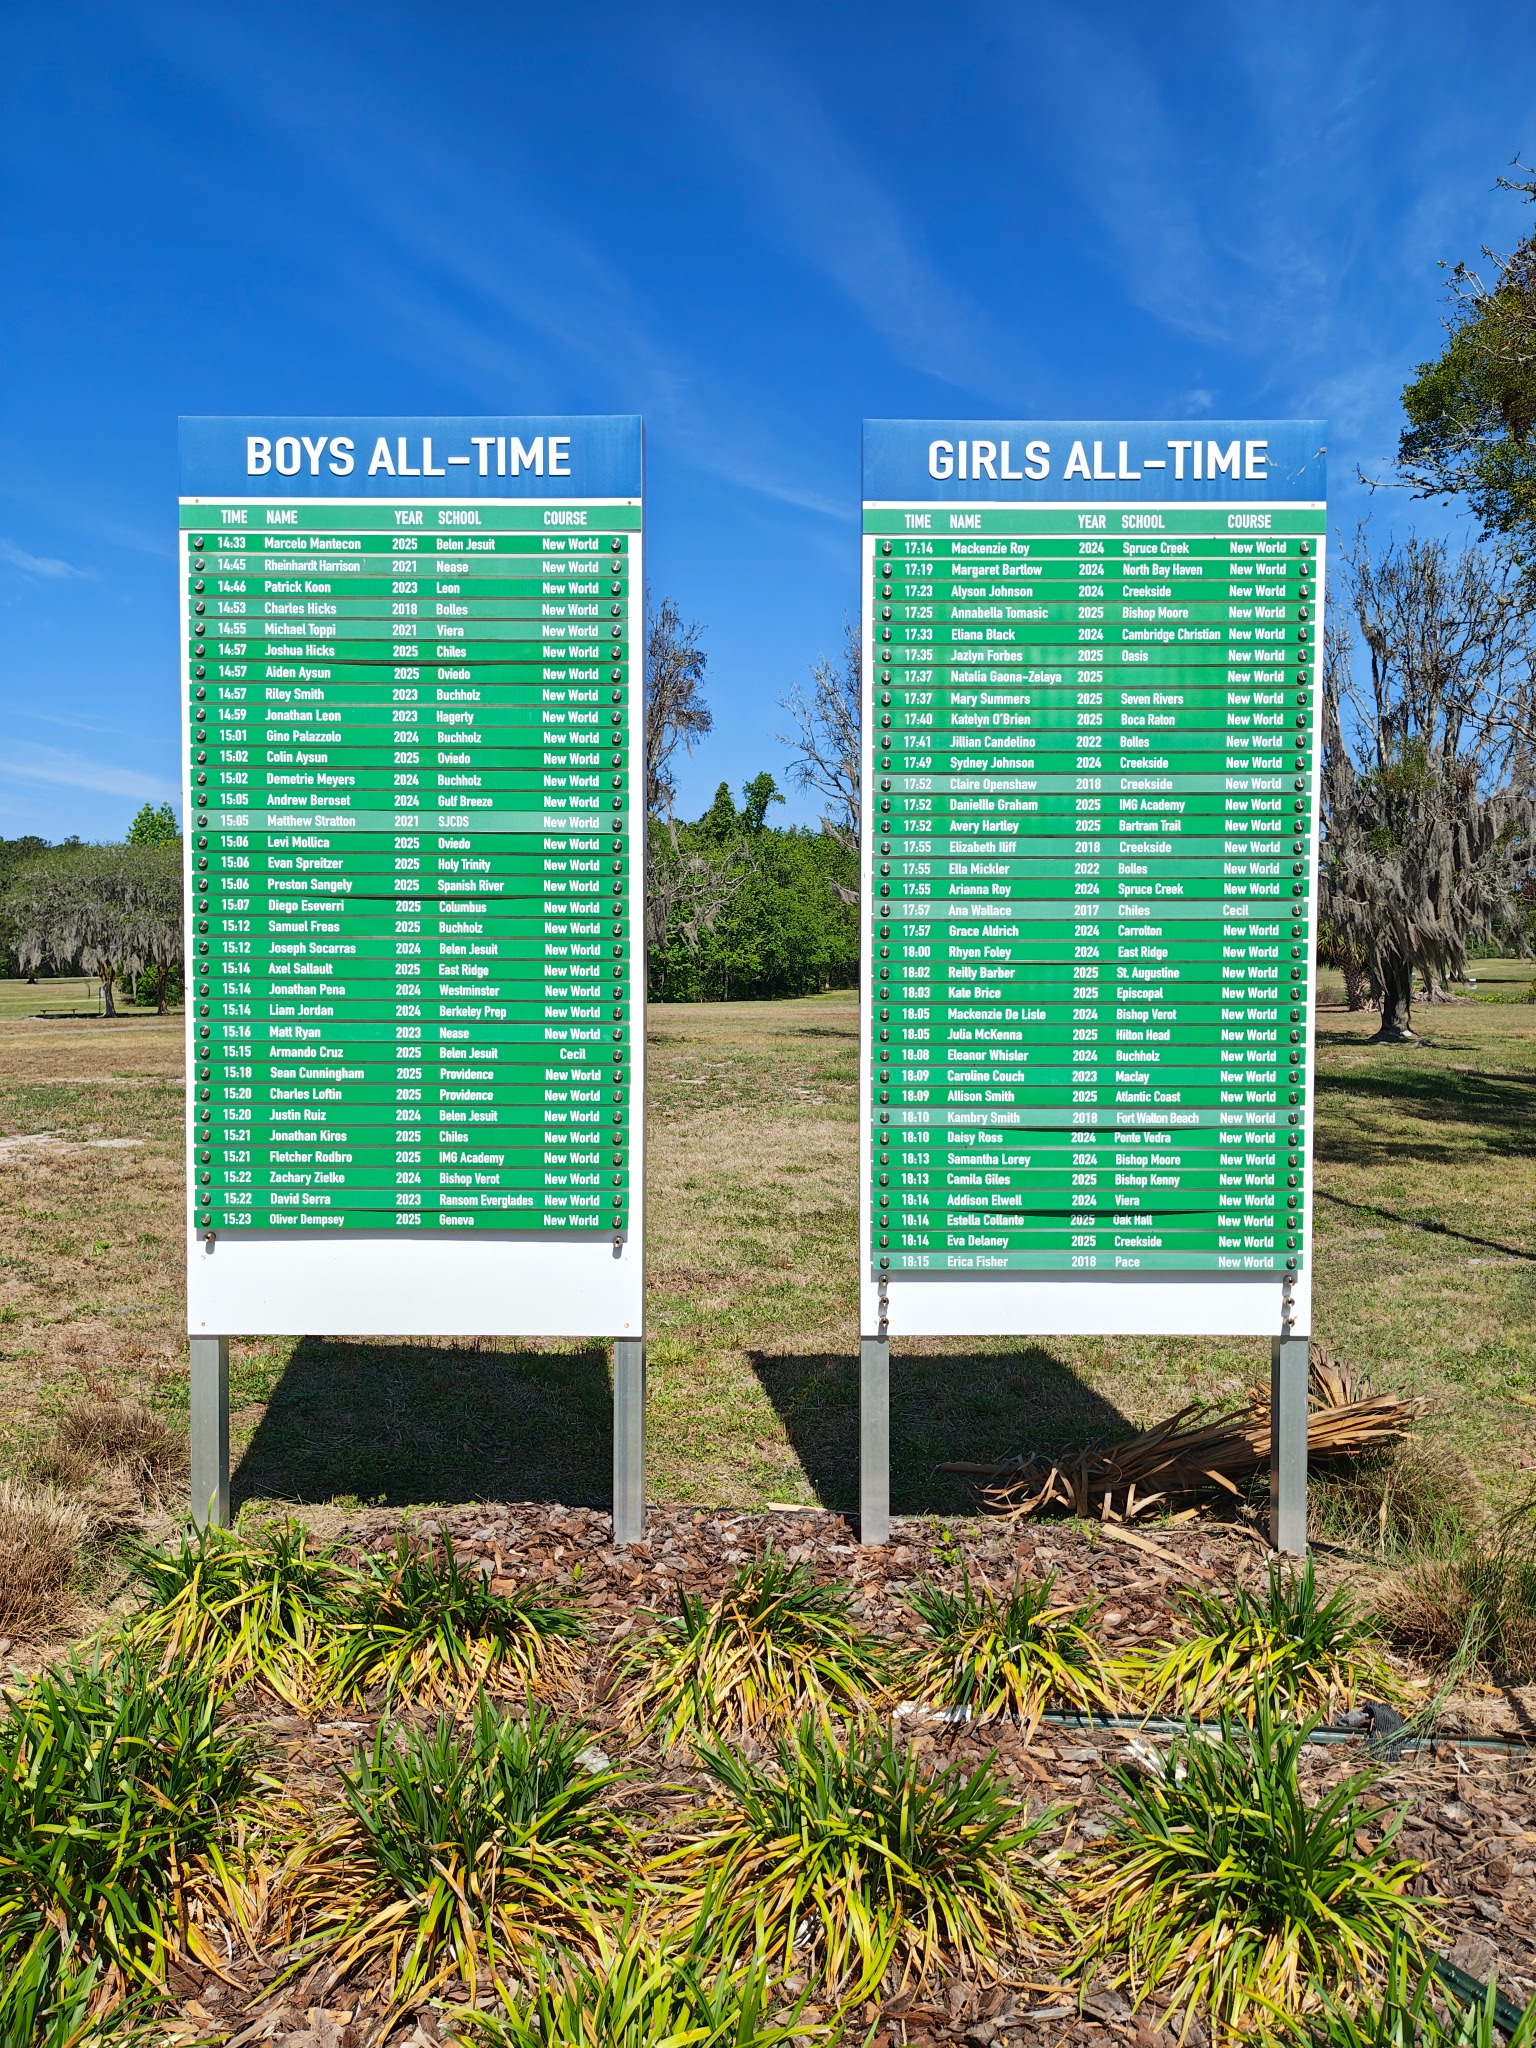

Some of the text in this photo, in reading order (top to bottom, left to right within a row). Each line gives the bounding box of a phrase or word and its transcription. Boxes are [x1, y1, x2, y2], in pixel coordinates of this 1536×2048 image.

[247, 436, 571, 476] BOYS ALL-TIME
[929, 440, 1268, 480] GIRLS ALL-TIME
[220, 509, 587, 525] TIME NAME YEAR SCHOOL COURSE
[904, 514, 1272, 529] TIME NAME YEAR SCHOOL COURSE
[217, 536, 599, 551] 14:33 Marcelo Mantecon 2025 Belen Jesuit New World
[905, 540, 1287, 557] 17:14 Mackenzie Roy 2024 Spruce Creek New World
[217, 601, 599, 616] 14:53 Charles Hicks 2018 Bolles New World
[905, 627, 1286, 644] 17:33 Eliana Black 2024 Cambridge Christian New World
[904, 692, 1284, 707] 17:37 Mary Summers 2025 Seven Rivers New World
[218, 708, 599, 725] 14:59 Jonathan Leon 2023 Hagerty New World
[904, 777, 1282, 794] 17:52 Claire Openshaw 2018 Creekside New World
[220, 814, 600, 829] 15:05 Matthew Stratton 2021 SJCDS New World
[221, 877, 600, 894] 15:06 Preston Sangely 2025 Spanish River New World
[903, 903, 1249, 917] 17:57 Ana Wallace 2017 Chiles Cecil
[222, 941, 601, 957] 15:12 Joseph Socarras 2024 Belen Jesuit New World
[902, 945, 1279, 962] 18:00 Rhyen Foley 2024 East Ridge New World
[223, 1045, 586, 1060] 15:15 Armando Cruz 2025 Belen Jesuit Cecil
[901, 1048, 1277, 1062] 18:08 Eleanor Whisler 2024 Buchholz New World
[223, 1128, 600, 1144] 15:21 Jonathan Kiros 2025 Chiles New World
[902, 1152, 1276, 1169] 18:13 Samantha Lorey 2024 Bishop Moore New World
[224, 1192, 600, 1209] 15:22 David Serra 2023 Ransom Everglades New World
[902, 1255, 1274, 1268] 18:15 Erica Fisher 2018 Pace New World
